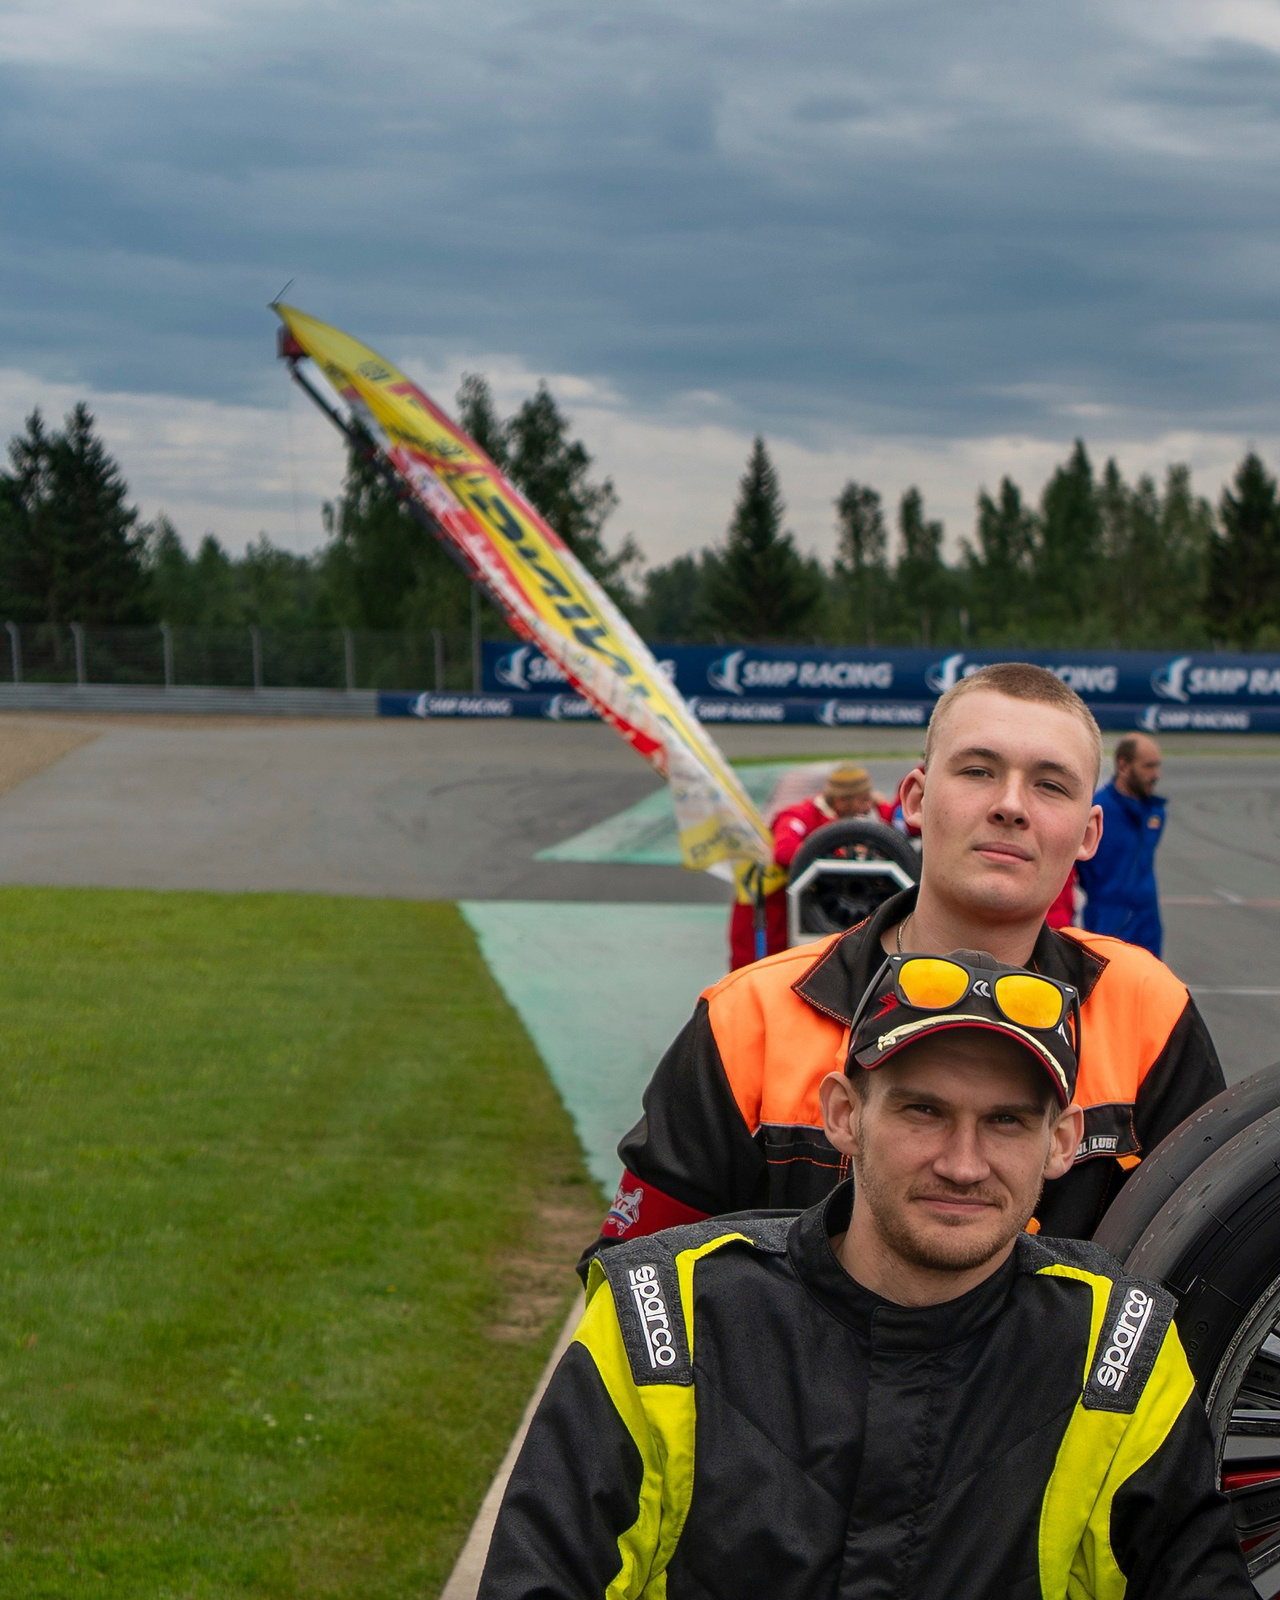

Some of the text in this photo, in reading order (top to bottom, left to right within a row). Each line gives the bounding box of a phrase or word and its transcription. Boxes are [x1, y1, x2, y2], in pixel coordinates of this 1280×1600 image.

[743, 660, 893, 689] SMP RACING
[1188, 669, 1247, 694] SMP
[628, 1264, 676, 1369] sparco
[1096, 1288, 1153, 1391] sparco
